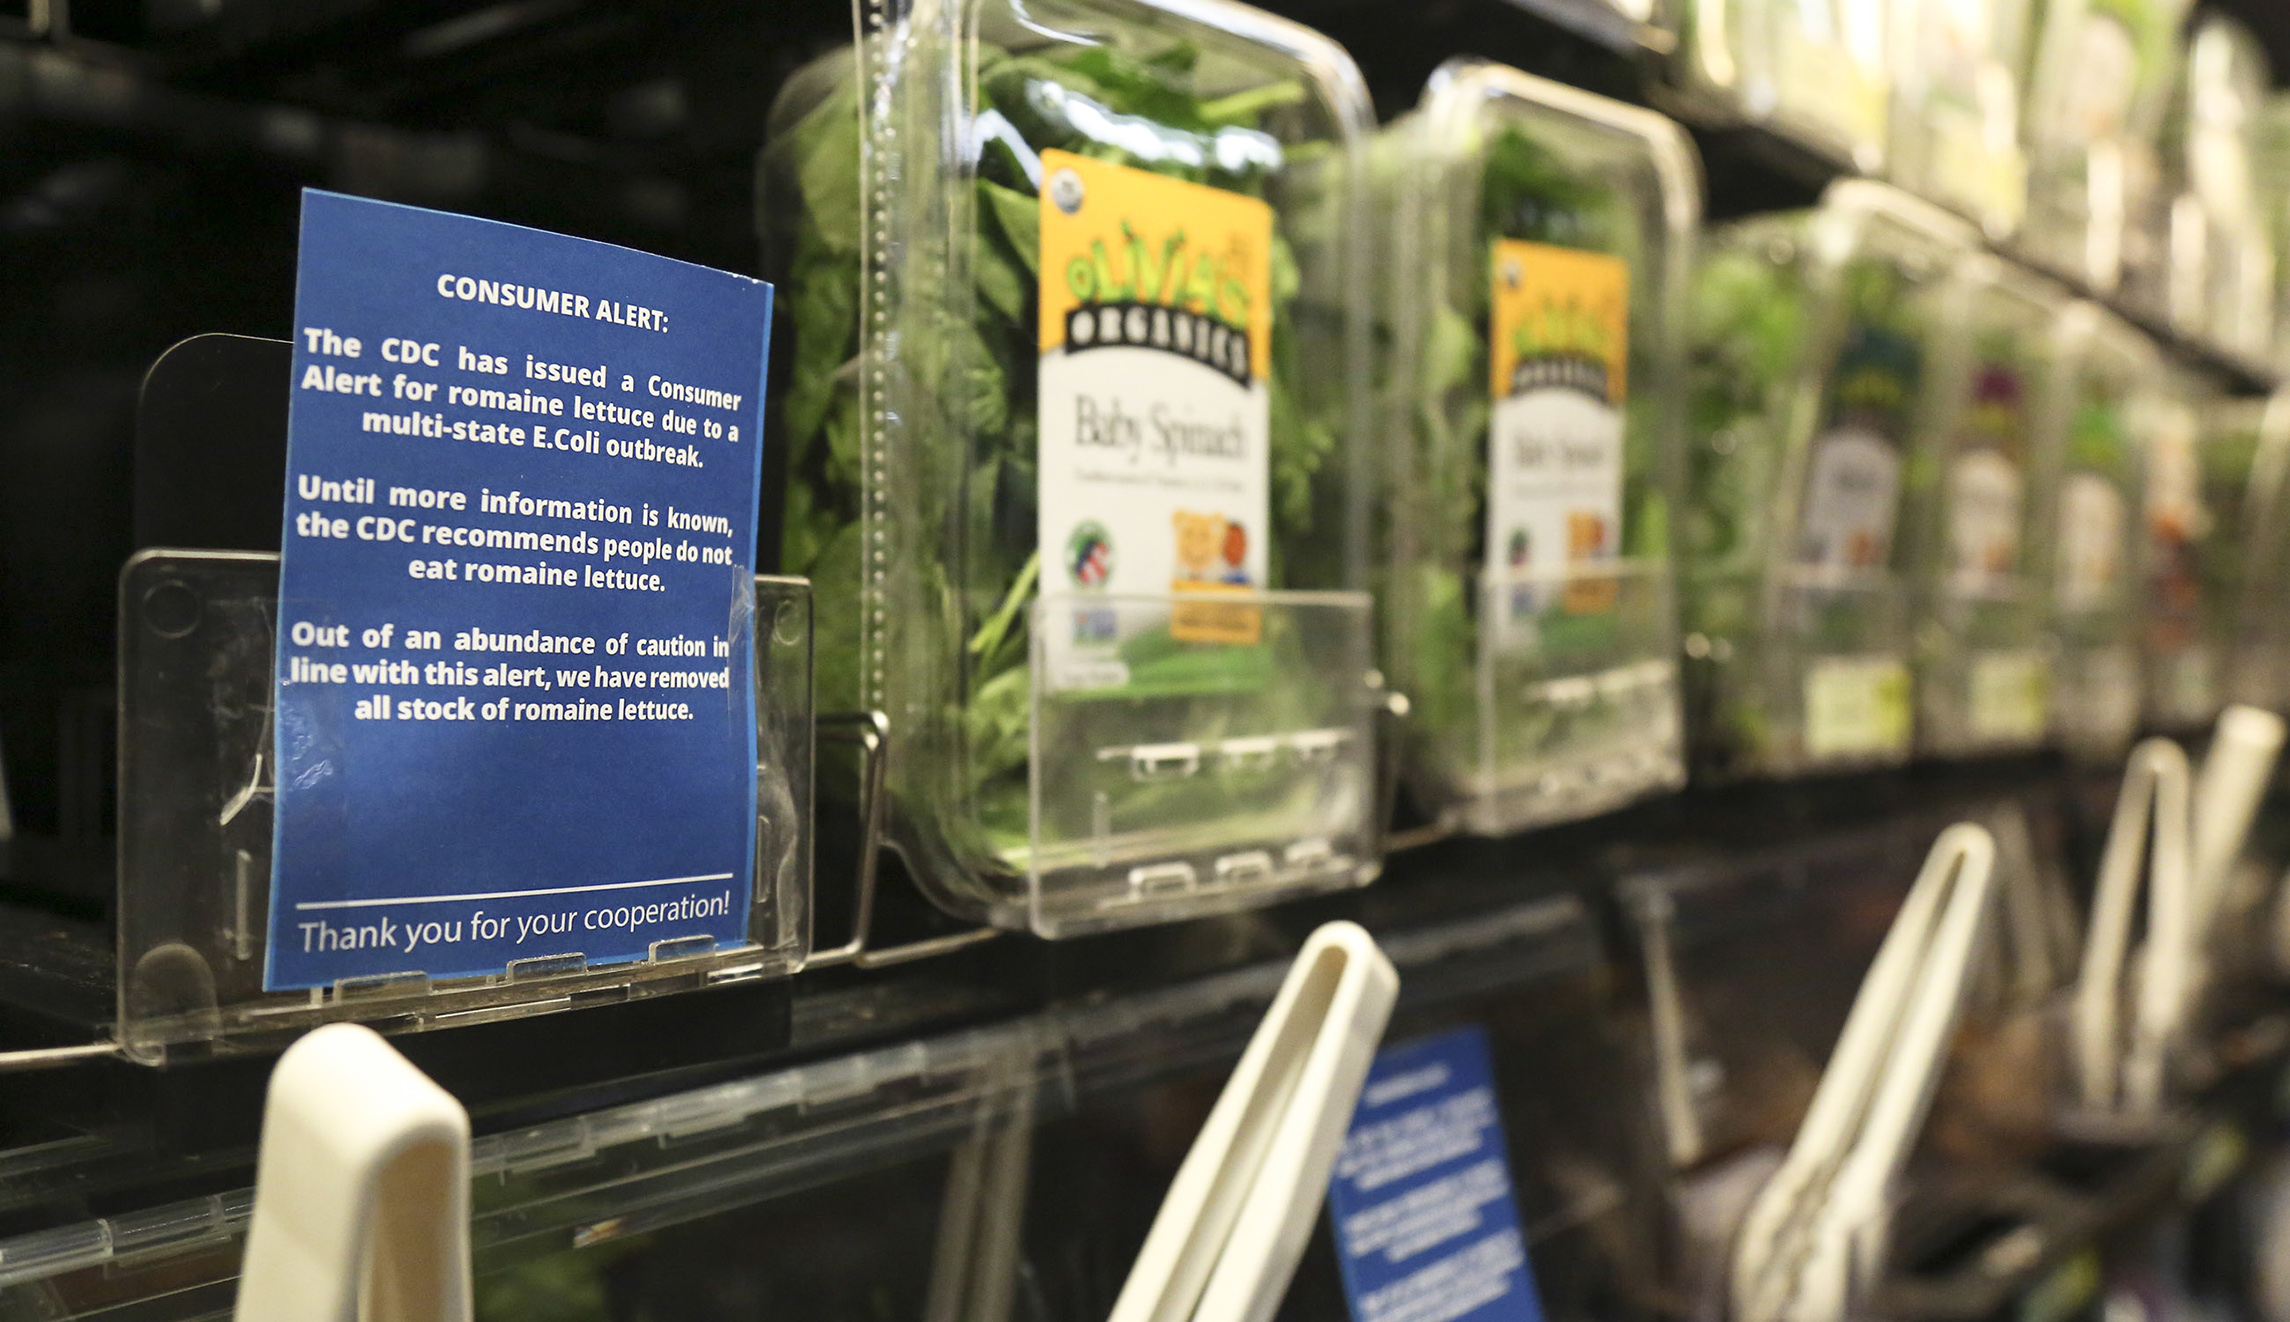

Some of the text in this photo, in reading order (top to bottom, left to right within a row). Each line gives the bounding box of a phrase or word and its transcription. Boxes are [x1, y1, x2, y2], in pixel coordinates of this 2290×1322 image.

[437, 273, 669, 334] CONSUMER ALERT:
[303, 327, 742, 412] The CDC has issued a Consumer
[1067, 305, 1251, 378] ORGANICS
[300, 364, 739, 443] Alert for romaine lettuce due to a
[1074, 394, 1248, 467] Baby Spinach
[362, 410, 704, 469] multi-state E.Coli outbreak.
[298, 474, 733, 538] Until more information is known,
[295, 510, 733, 566] the CDC recommends people do not
[408, 558, 666, 592] eat romaine lettuce.
[291, 621, 731, 658] Out of an abundance of caution in
[289, 656, 730, 691] line with this alert, we have removed
[354, 694, 694, 721] all stock of romaine lettuce.
[297, 890, 730, 953] Thank you for your cooperation!
